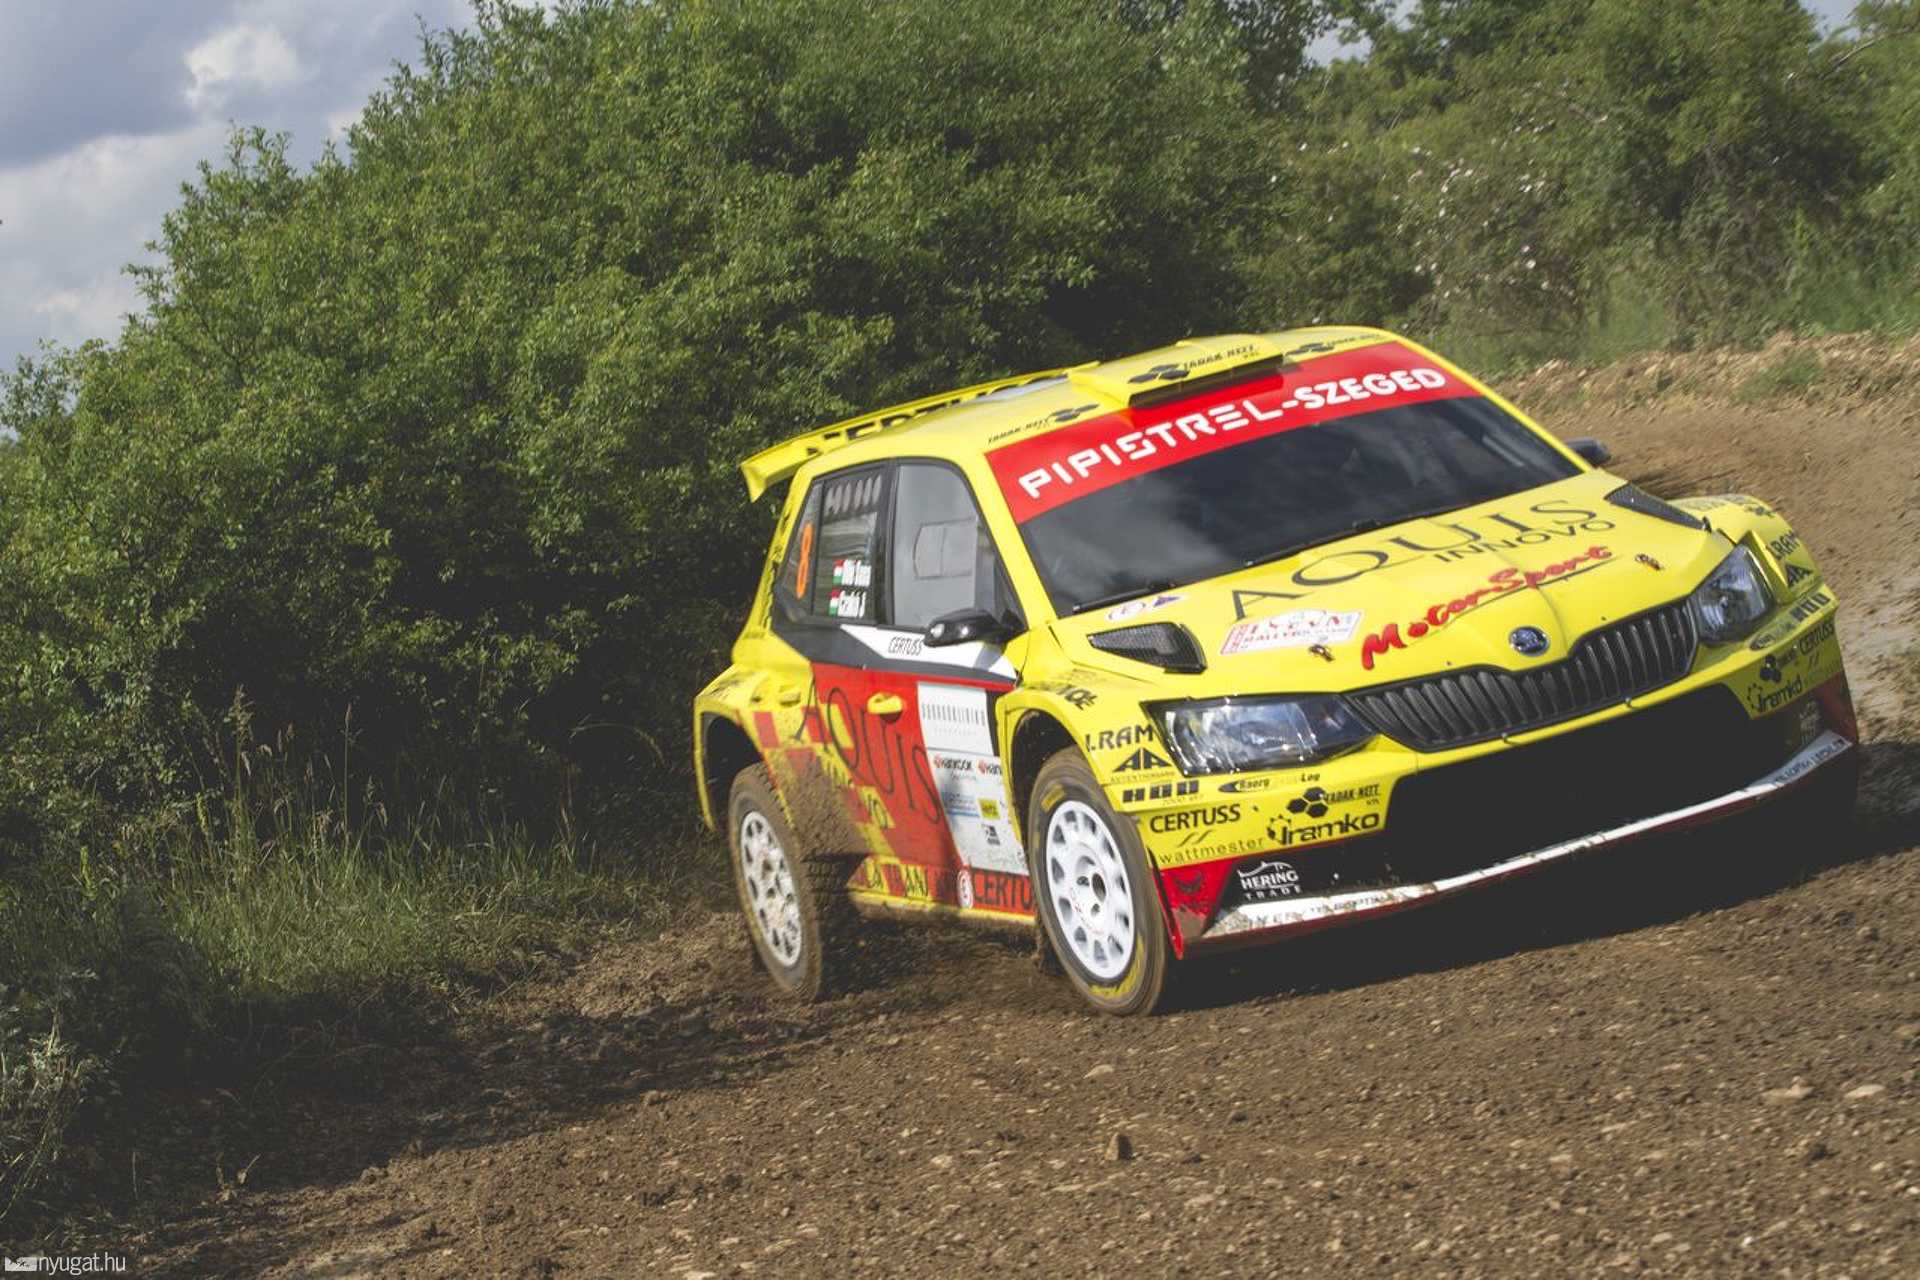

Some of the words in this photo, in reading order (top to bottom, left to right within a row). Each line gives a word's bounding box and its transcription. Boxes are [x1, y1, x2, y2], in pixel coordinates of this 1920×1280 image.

[1018, 368, 1446, 499] PIPISTREL-SZEGED
[1433, 519, 1615, 562] INNOVO
[1232, 500, 1597, 620] AQUIS
[888, 636, 923, 657] CERTUSS
[795, 675, 942, 825] AQUIS
[1149, 803, 1241, 834] CERTUSS
[1159, 837, 1264, 865] wattmester
[1240, 869, 1300, 891] HERING
[1245, 885, 1302, 901] TRADE
